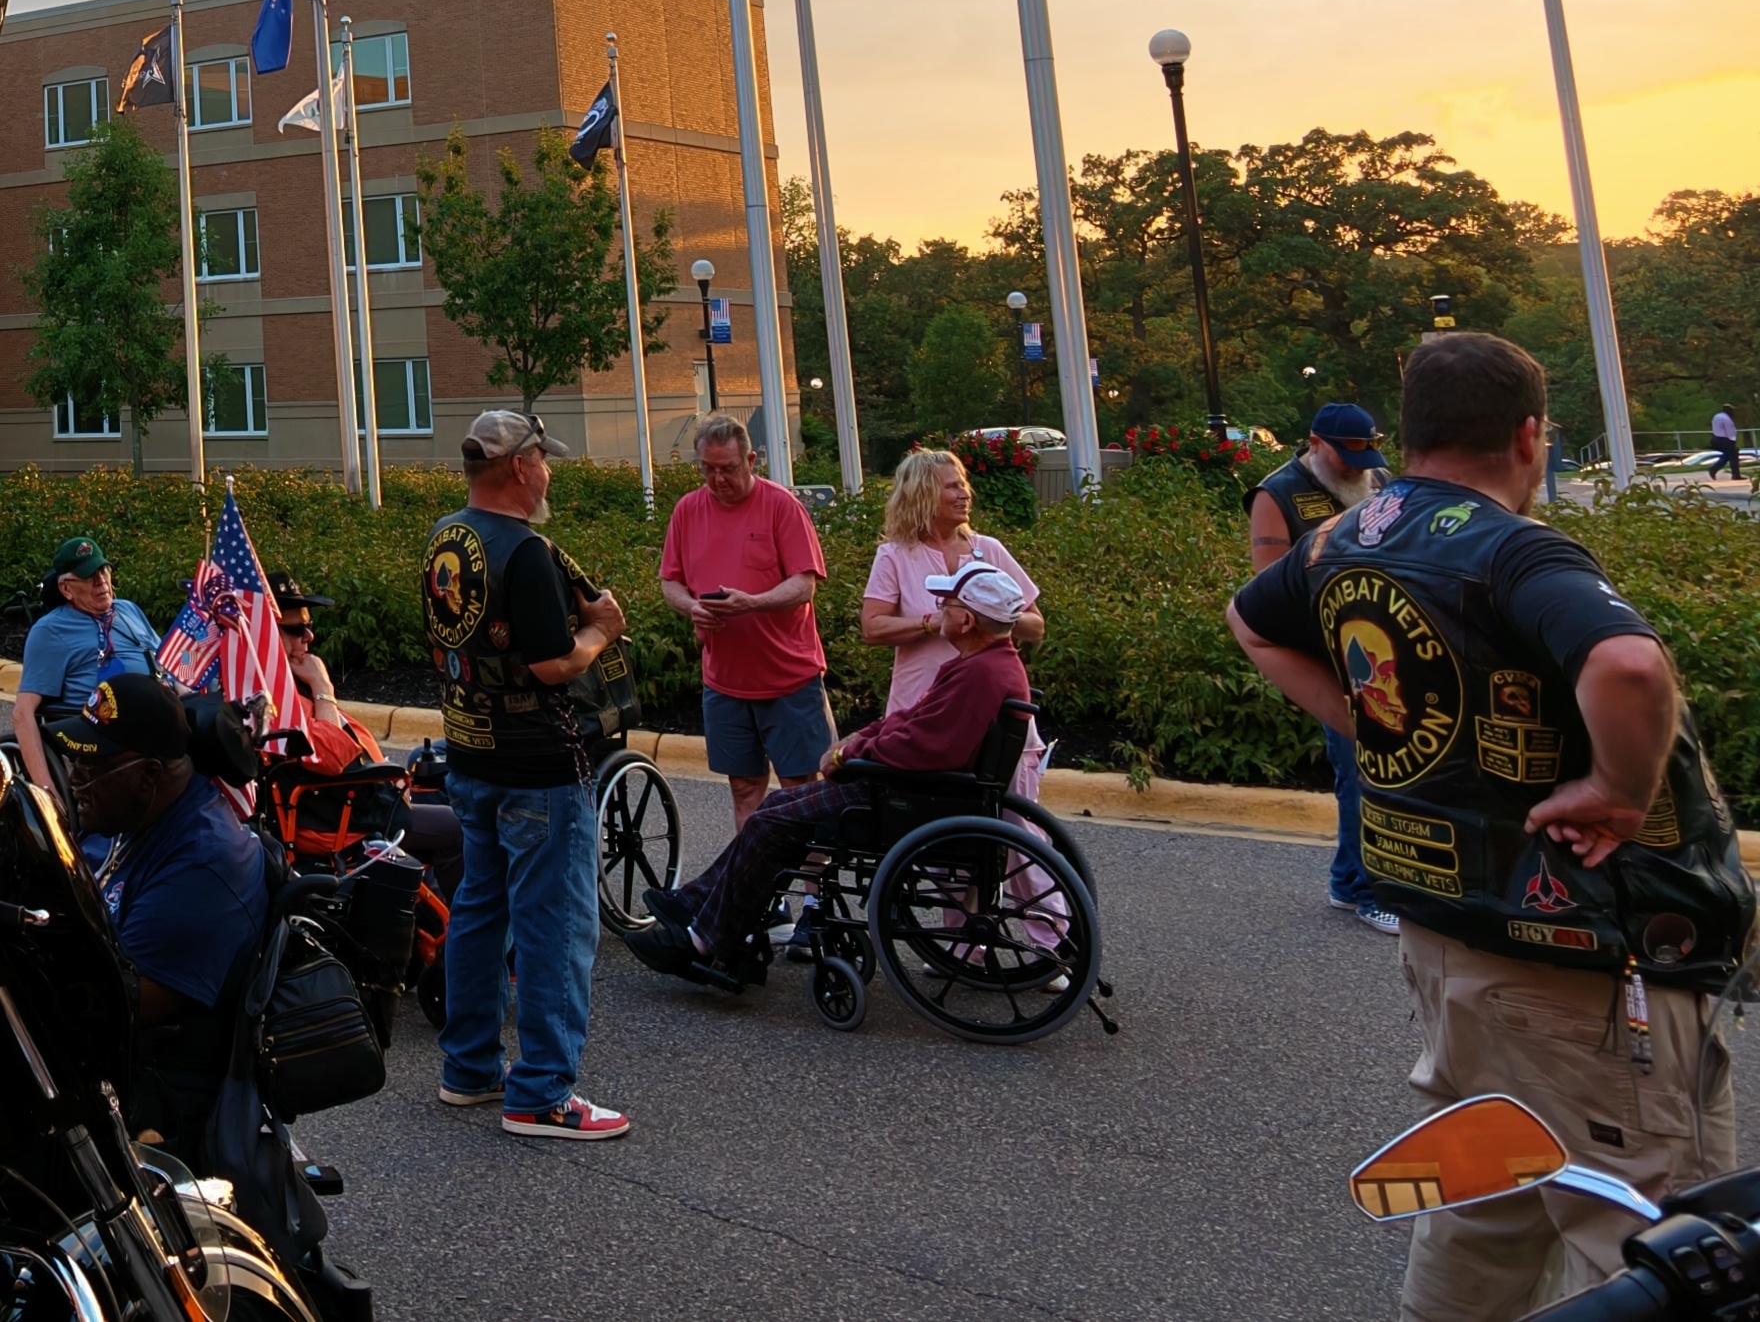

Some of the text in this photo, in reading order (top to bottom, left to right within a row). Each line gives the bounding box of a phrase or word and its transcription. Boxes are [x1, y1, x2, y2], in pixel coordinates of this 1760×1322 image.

[423, 527, 484, 573] COMBAT VETS
[1388, 587, 1443, 661] VETS
[67, 741, 82, 752] INF
[82, 743, 98, 753] DIV
[1390, 817, 1431, 837] STORM
[1374, 834, 1419, 860] SOMALIA
[1421, 872, 1456, 892] VETS
